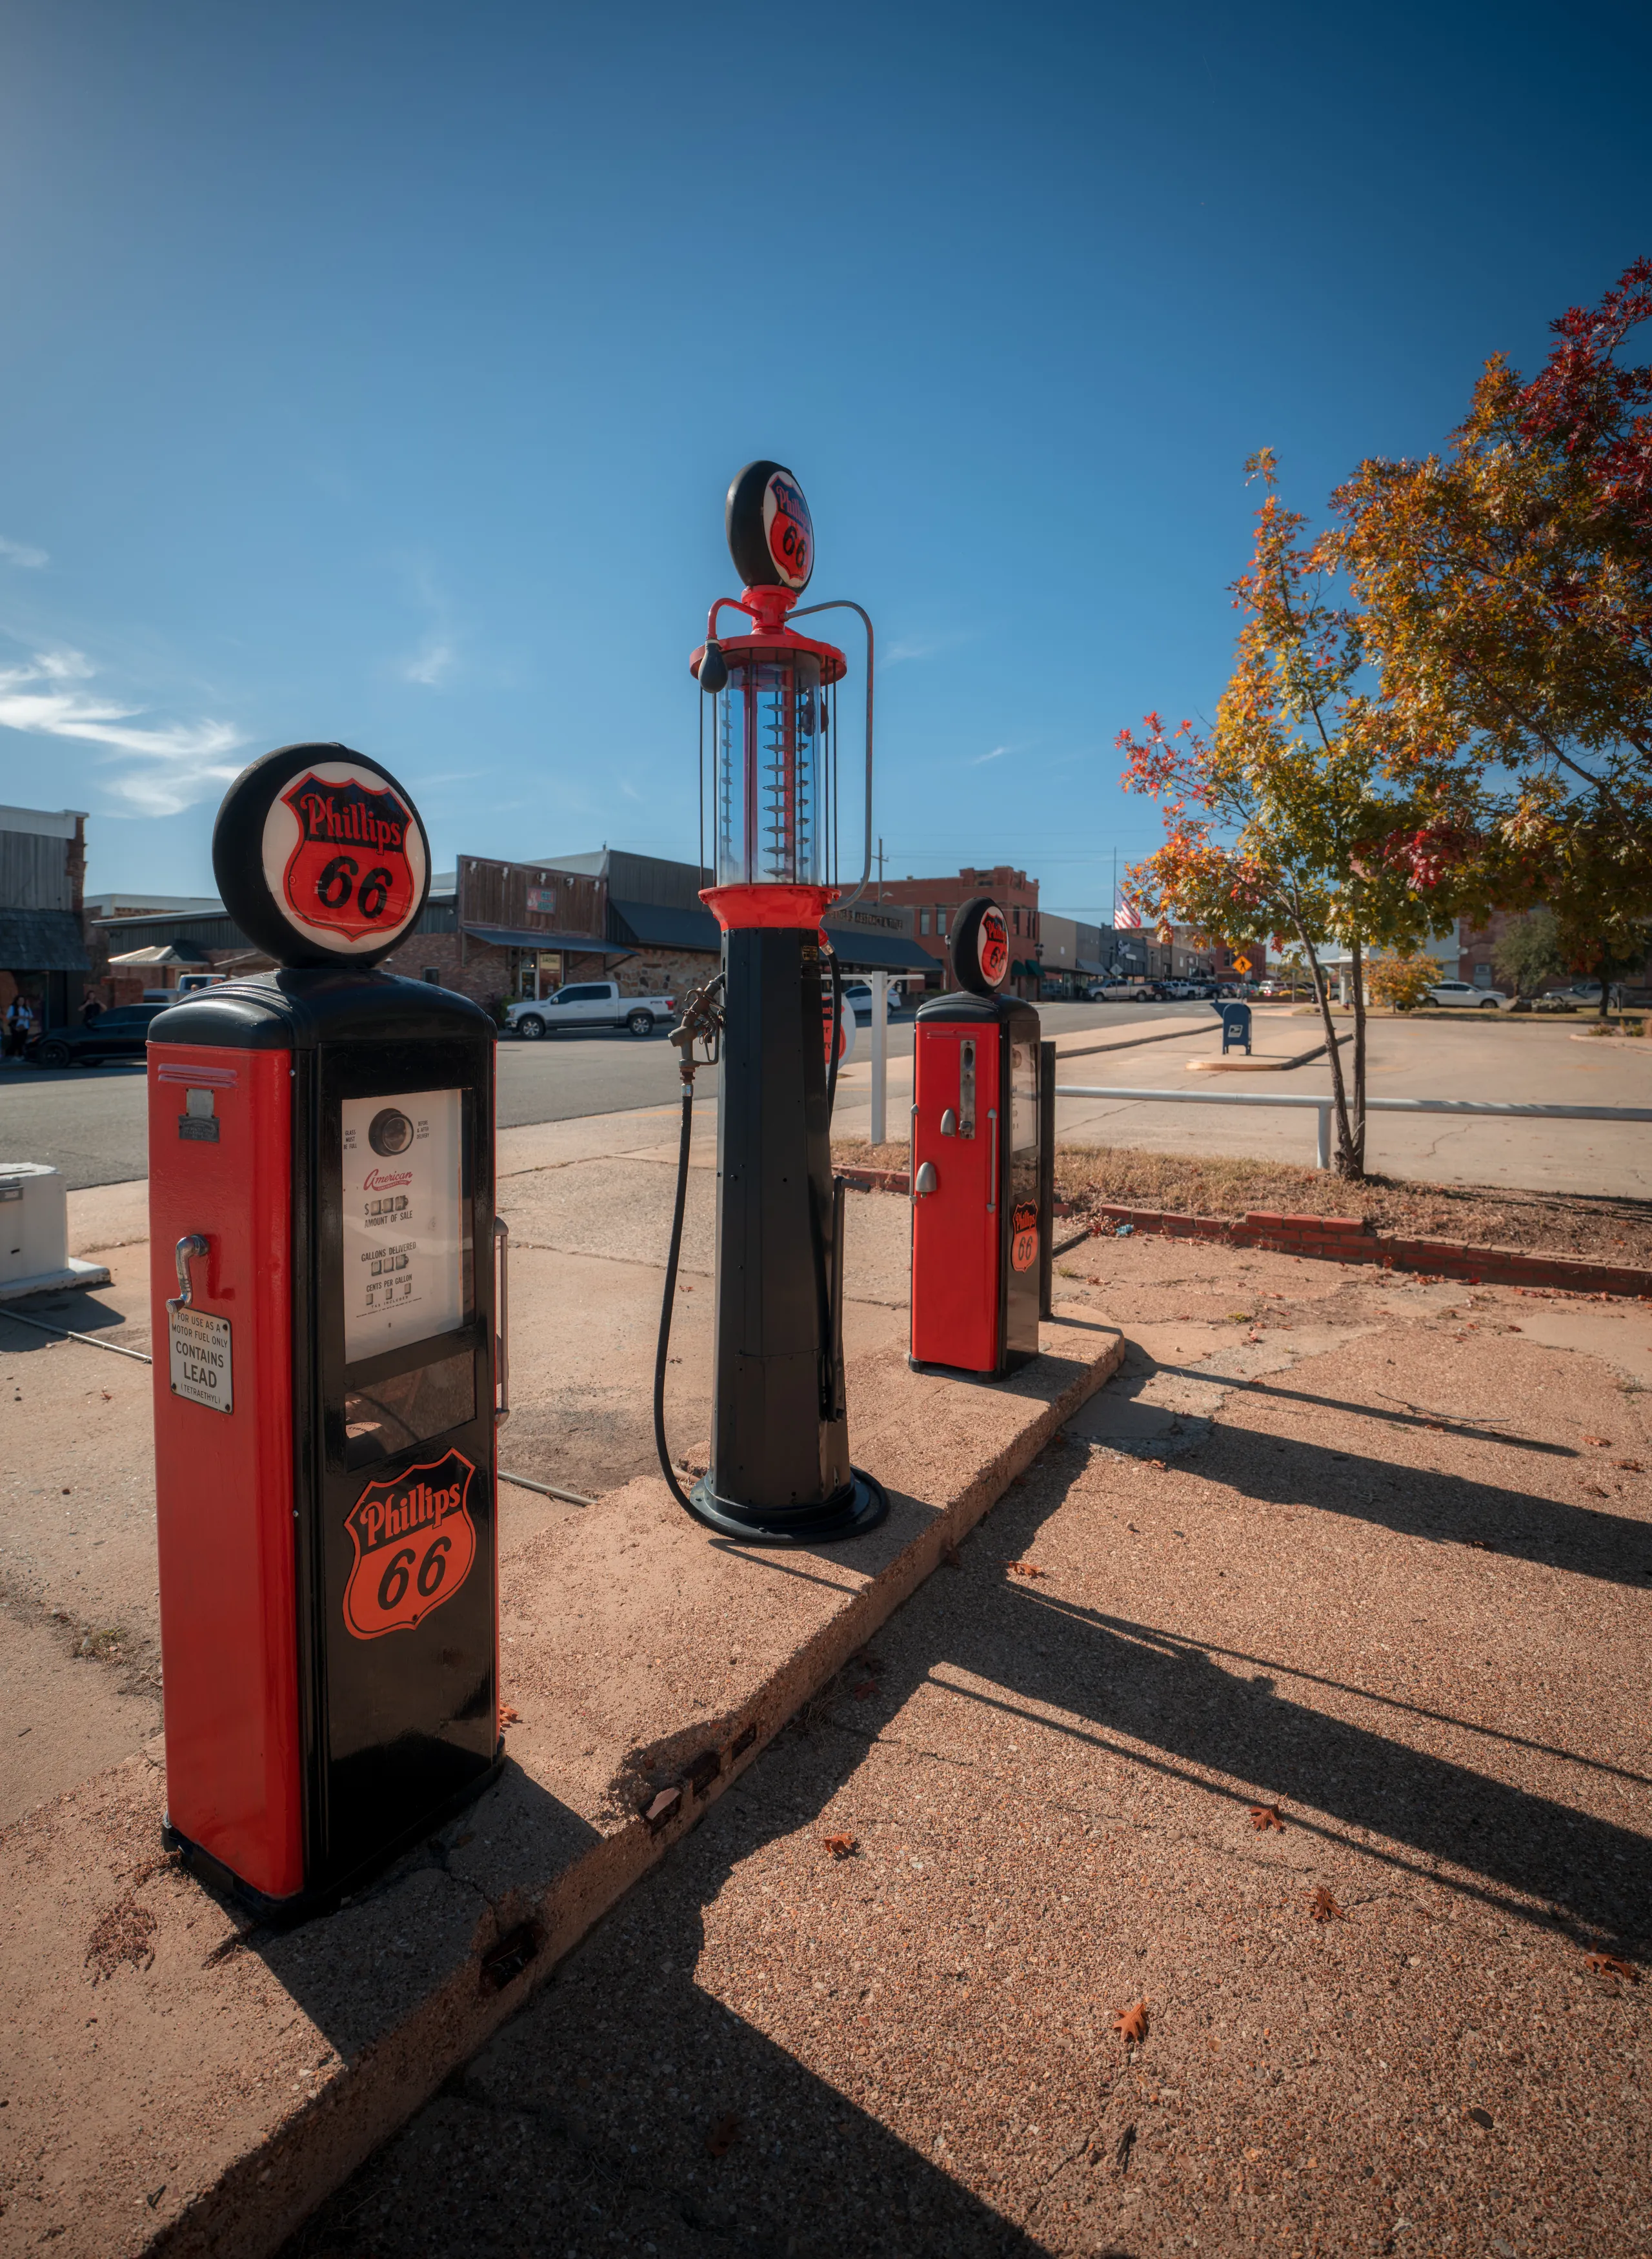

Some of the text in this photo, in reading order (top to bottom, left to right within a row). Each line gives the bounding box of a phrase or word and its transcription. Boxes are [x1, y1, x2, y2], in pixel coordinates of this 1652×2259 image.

[783, 525, 807, 568] 66
[300, 793, 401, 855] Phillips
[317, 856, 392, 919] 66
[991, 946, 1005, 972] 66
[363, 1168, 413, 1191] American
[364, 1210, 413, 1228] AMOUNT OF SALE
[1016, 1210, 1035, 1231] Phillips
[361, 1242, 416, 1262] GALLONS DELIVERED
[1018, 1236, 1032, 1261] 66
[367, 1282, 381, 1292] CENTS
[395, 1274, 412, 1284] GALLON
[384, 1296, 408, 1305] INCLUDED
[177, 1312, 221, 1333] FOR USE AS A
[172, 1323, 228, 1348] MOTOR FUEL ONLY
[176, 1341, 224, 1368] CONTAINS
[184, 1362, 217, 1388] LEAD
[181, 1383, 221, 1404] (TETRAETHYL)
[360, 1483, 460, 1546] Phillips
[378, 1536, 452, 1610] 66
